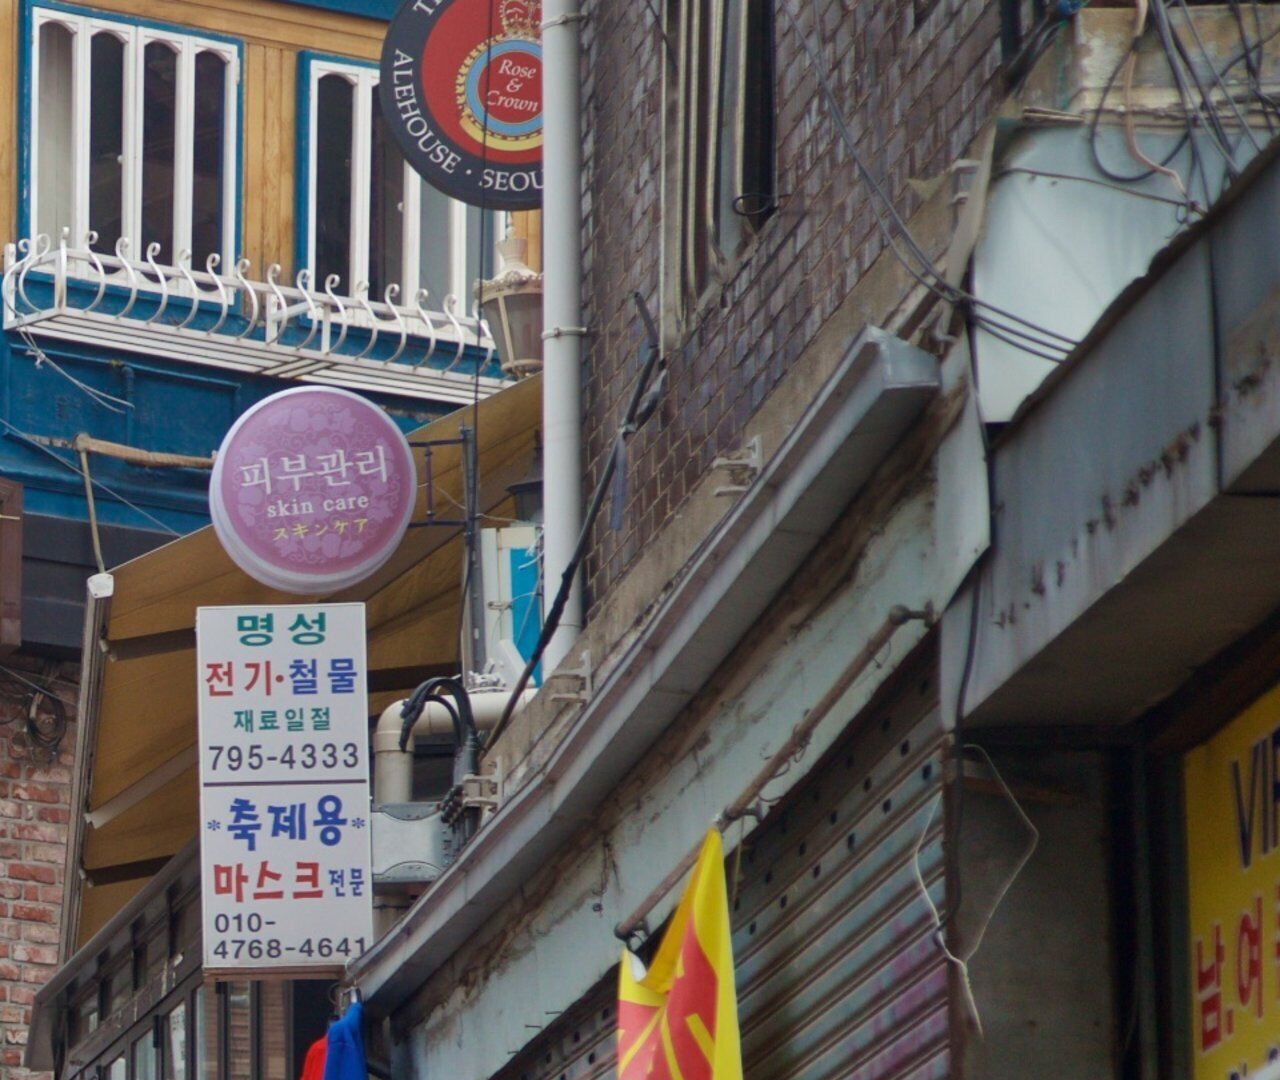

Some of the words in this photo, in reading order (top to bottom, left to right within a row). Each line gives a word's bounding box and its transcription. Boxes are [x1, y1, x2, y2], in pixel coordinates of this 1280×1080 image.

[499, 58, 537, 79] Rose
[506, 78, 523, 92] &
[393, 49, 462, 174] ALEHOUSE
[486, 90, 539, 112] Crown
[479, 168, 544, 191] SEOU
[240, 445, 387, 494] 피부관리
[267, 499, 314, 517] skin
[323, 496, 369, 512] care
[273, 518, 368, 540] スキンケア
[233, 708, 331, 733] 재료일절
[209, 742, 360, 771] 795-4333
[227, 796, 347, 850] 축제용
[214, 861, 324, 903] 마스크
[328, 867, 364, 898] 전문
[214, 912, 276, 934] 010-
[214, 938, 367, 960] 4768-4641
